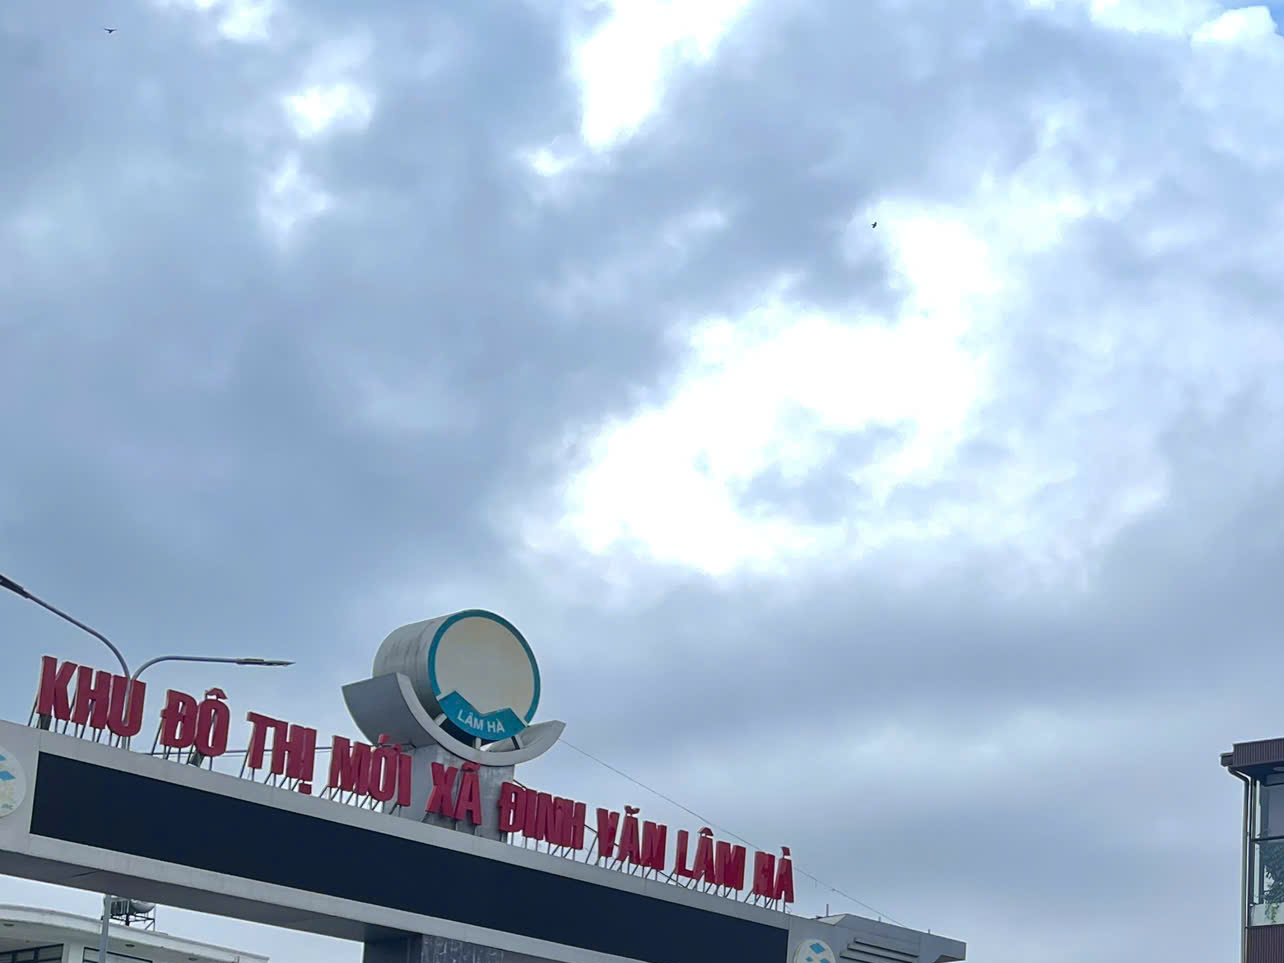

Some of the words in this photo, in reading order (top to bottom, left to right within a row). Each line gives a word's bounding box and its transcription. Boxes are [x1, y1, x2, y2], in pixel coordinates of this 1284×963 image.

[36, 655, 147, 738] KHU
[159, 687, 231, 757] ĐÔ
[247, 711, 318, 795] THỊ
[329, 733, 414, 808] MỚI
[425, 761, 484, 827] XÃ
[498, 781, 588, 850] ĐINH
[596, 805, 668, 871] VĂN
[676, 827, 748, 891] LÂM
[753, 846, 795, 904] HÀ
[456, 708, 486, 732] LÂM
[486, 718, 506, 735] HÀ
